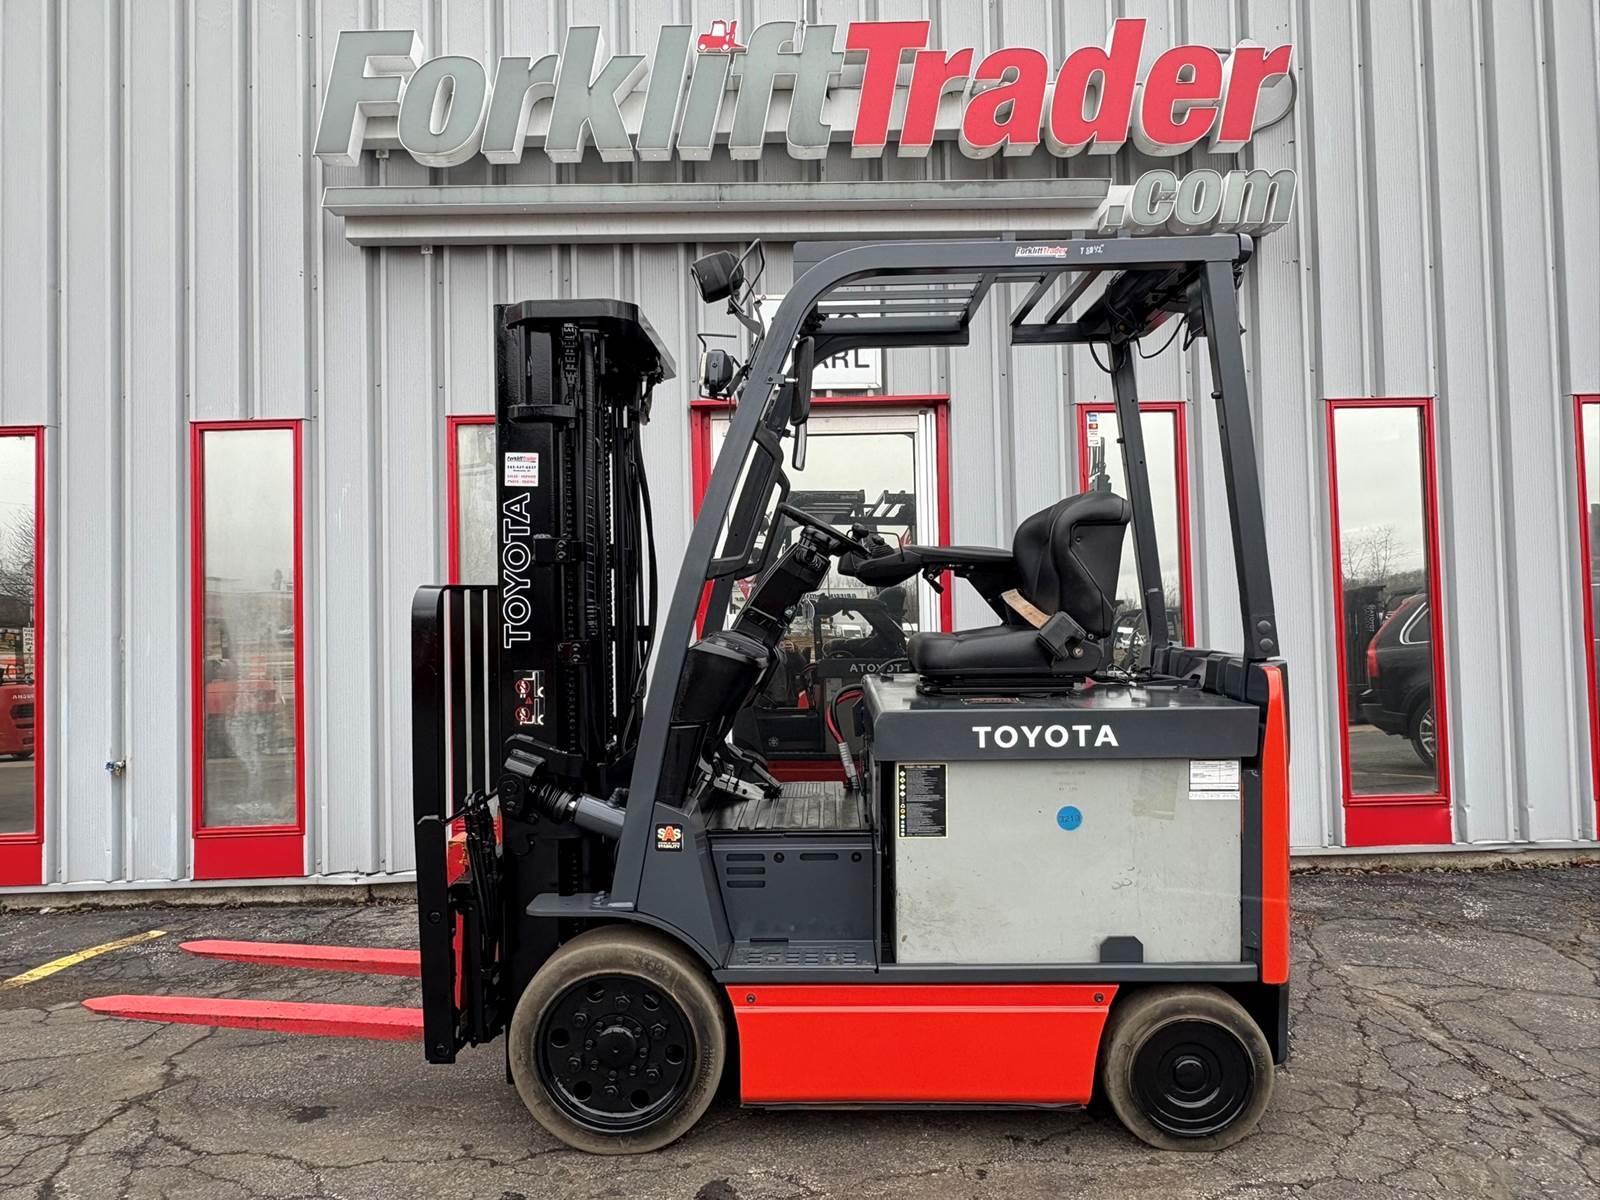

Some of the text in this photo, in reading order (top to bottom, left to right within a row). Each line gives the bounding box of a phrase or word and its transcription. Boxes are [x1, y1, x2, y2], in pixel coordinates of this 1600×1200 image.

[1104, 169, 1297, 230] .com
[503, 492, 531, 648] TOYOTA
[971, 724, 1119, 749] TOYOTA
[657, 826, 681, 841] SAS
